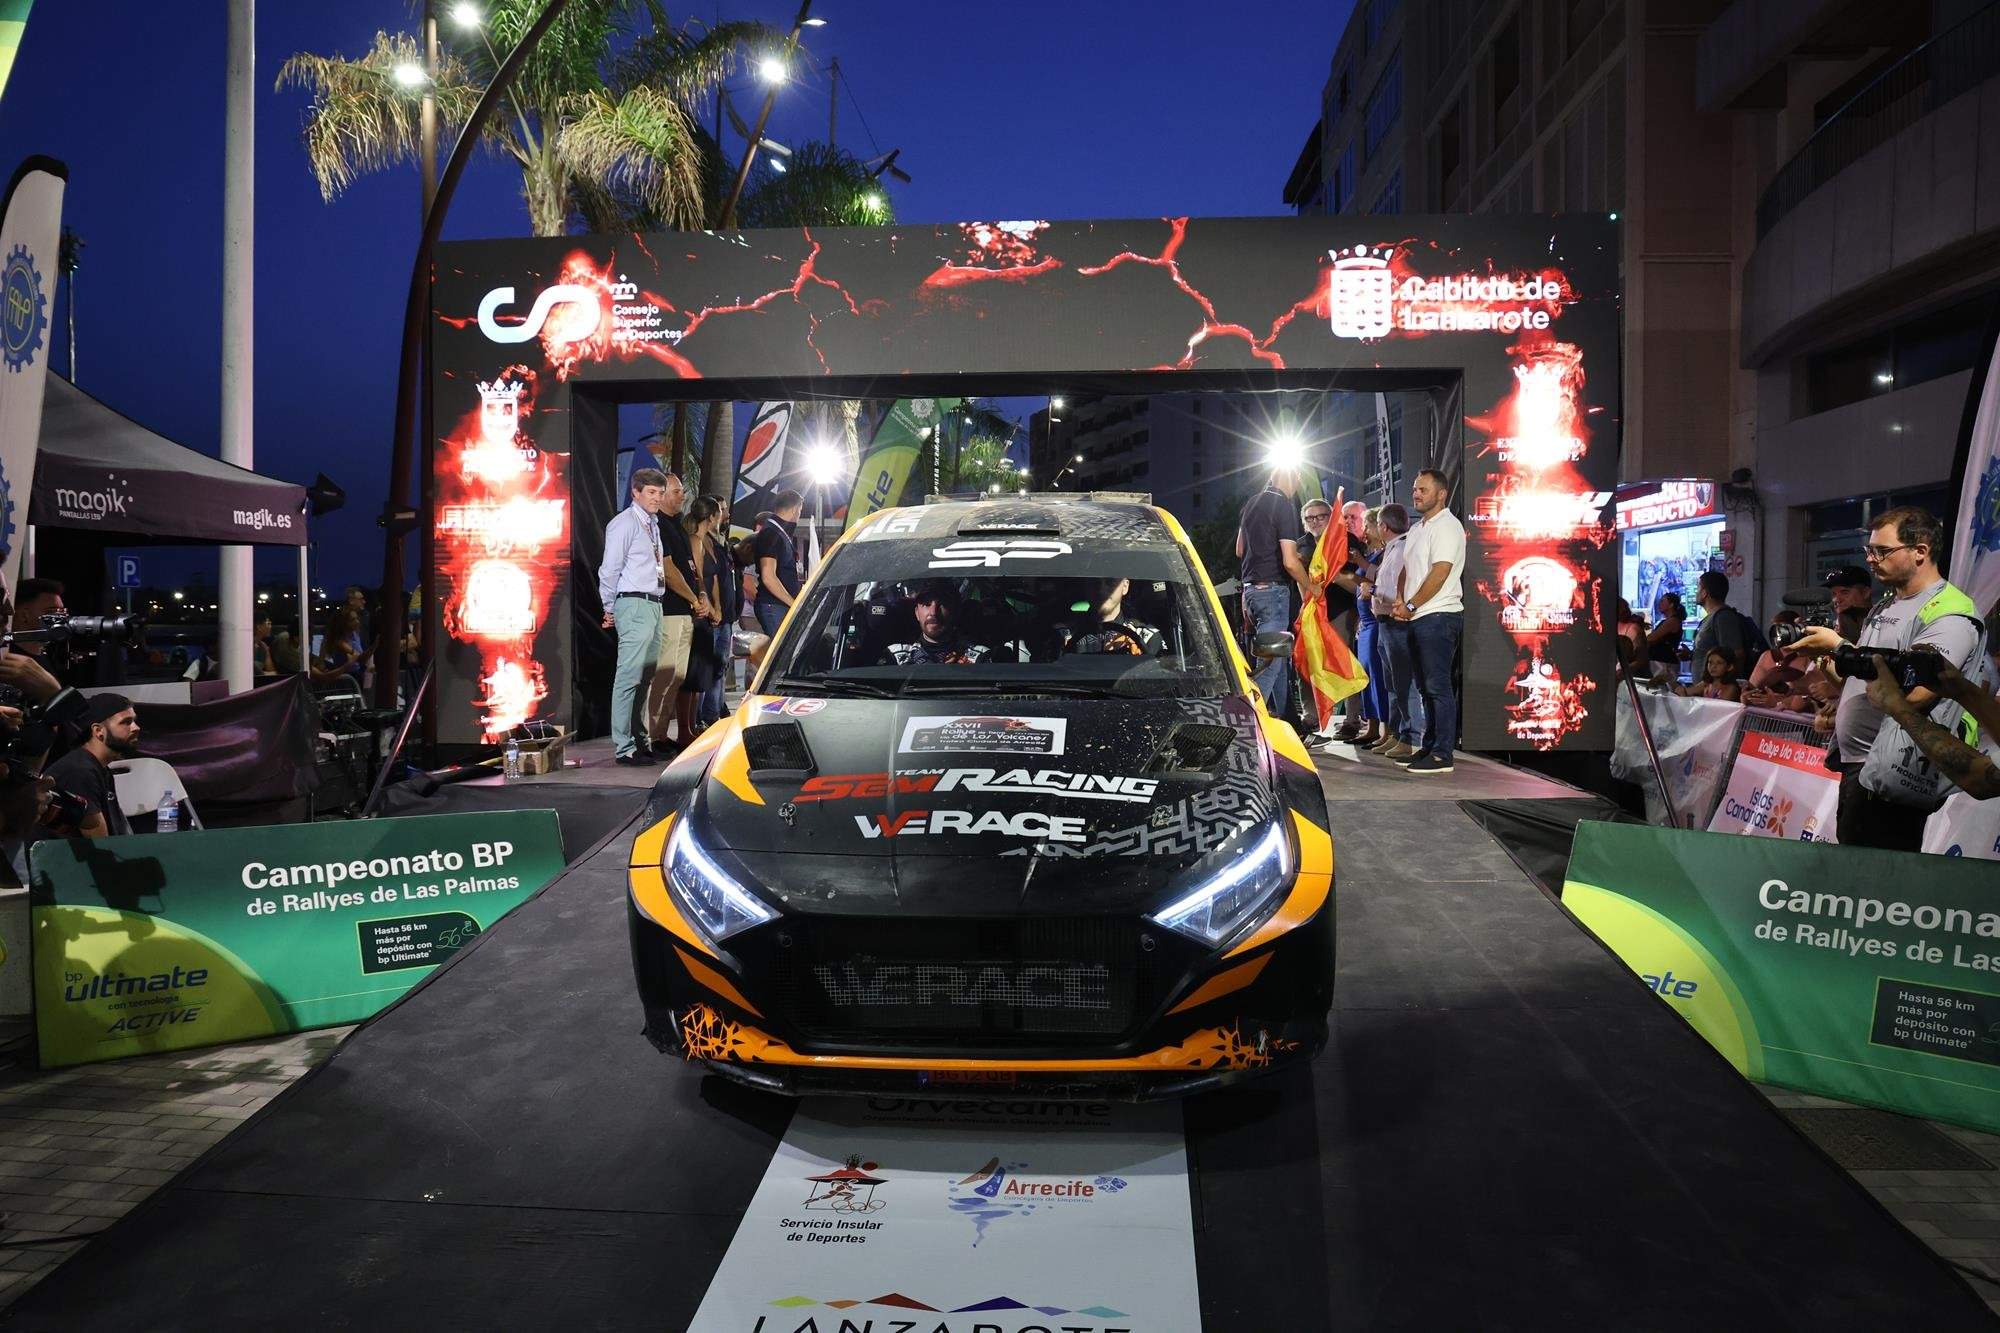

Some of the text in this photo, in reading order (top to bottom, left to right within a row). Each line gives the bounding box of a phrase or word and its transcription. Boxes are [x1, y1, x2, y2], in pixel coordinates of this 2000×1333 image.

[1526, 276, 1560, 300] de
[612, 303, 659, 317] Consejo
[612, 315, 662, 328] Superior
[631, 329, 682, 341] Deportes
[56, 488, 126, 517] magik
[59, 510, 90, 521] PANTALLAS
[233, 508, 292, 530] magik.es
[1631, 499, 1698, 527] REDUCTO
[123, 560, 136, 583] P
[941, 728, 976, 736] Rallye
[997, 733, 1048, 742] Volcanes
[1758, 739, 1780, 758] Rallye
[895, 768, 945, 776] TEAM
[933, 768, 1159, 803] RACING
[1749, 787, 1774, 811] Islas
[1725, 798, 1768, 829] Canarias
[854, 810, 1087, 843] WERACE
[242, 841, 513, 889] Campeonato BP
[247, 876, 520, 916] de Rallyes de Las Palmas
[374, 927, 399, 935] Hasta
[376, 935, 411, 945] más por
[377, 943, 415, 955] depósito
[1754, 919, 1788, 941] de
[1795, 923, 1897, 957] Rallyes
[1905, 940, 1943, 964] de
[378, 956, 390, 964] bp
[65, 971, 83, 983] bp
[65, 966, 208, 1002] ultimate
[107, 1002, 126, 1010] con
[1899, 991, 1975, 1011] Hasta 56 km
[107, 1007, 202, 1033] ACTIVE
[1897, 1004, 1948, 1020] más por
[1894, 1027, 1909, 1039] bp
[1895, 1015, 1975, 1037] depósito con
[1005, 1178, 1094, 1197] Arrecife
[780, 1219, 884, 1230] Servicio Insular
[787, 1232, 866, 1244] de Deportes
